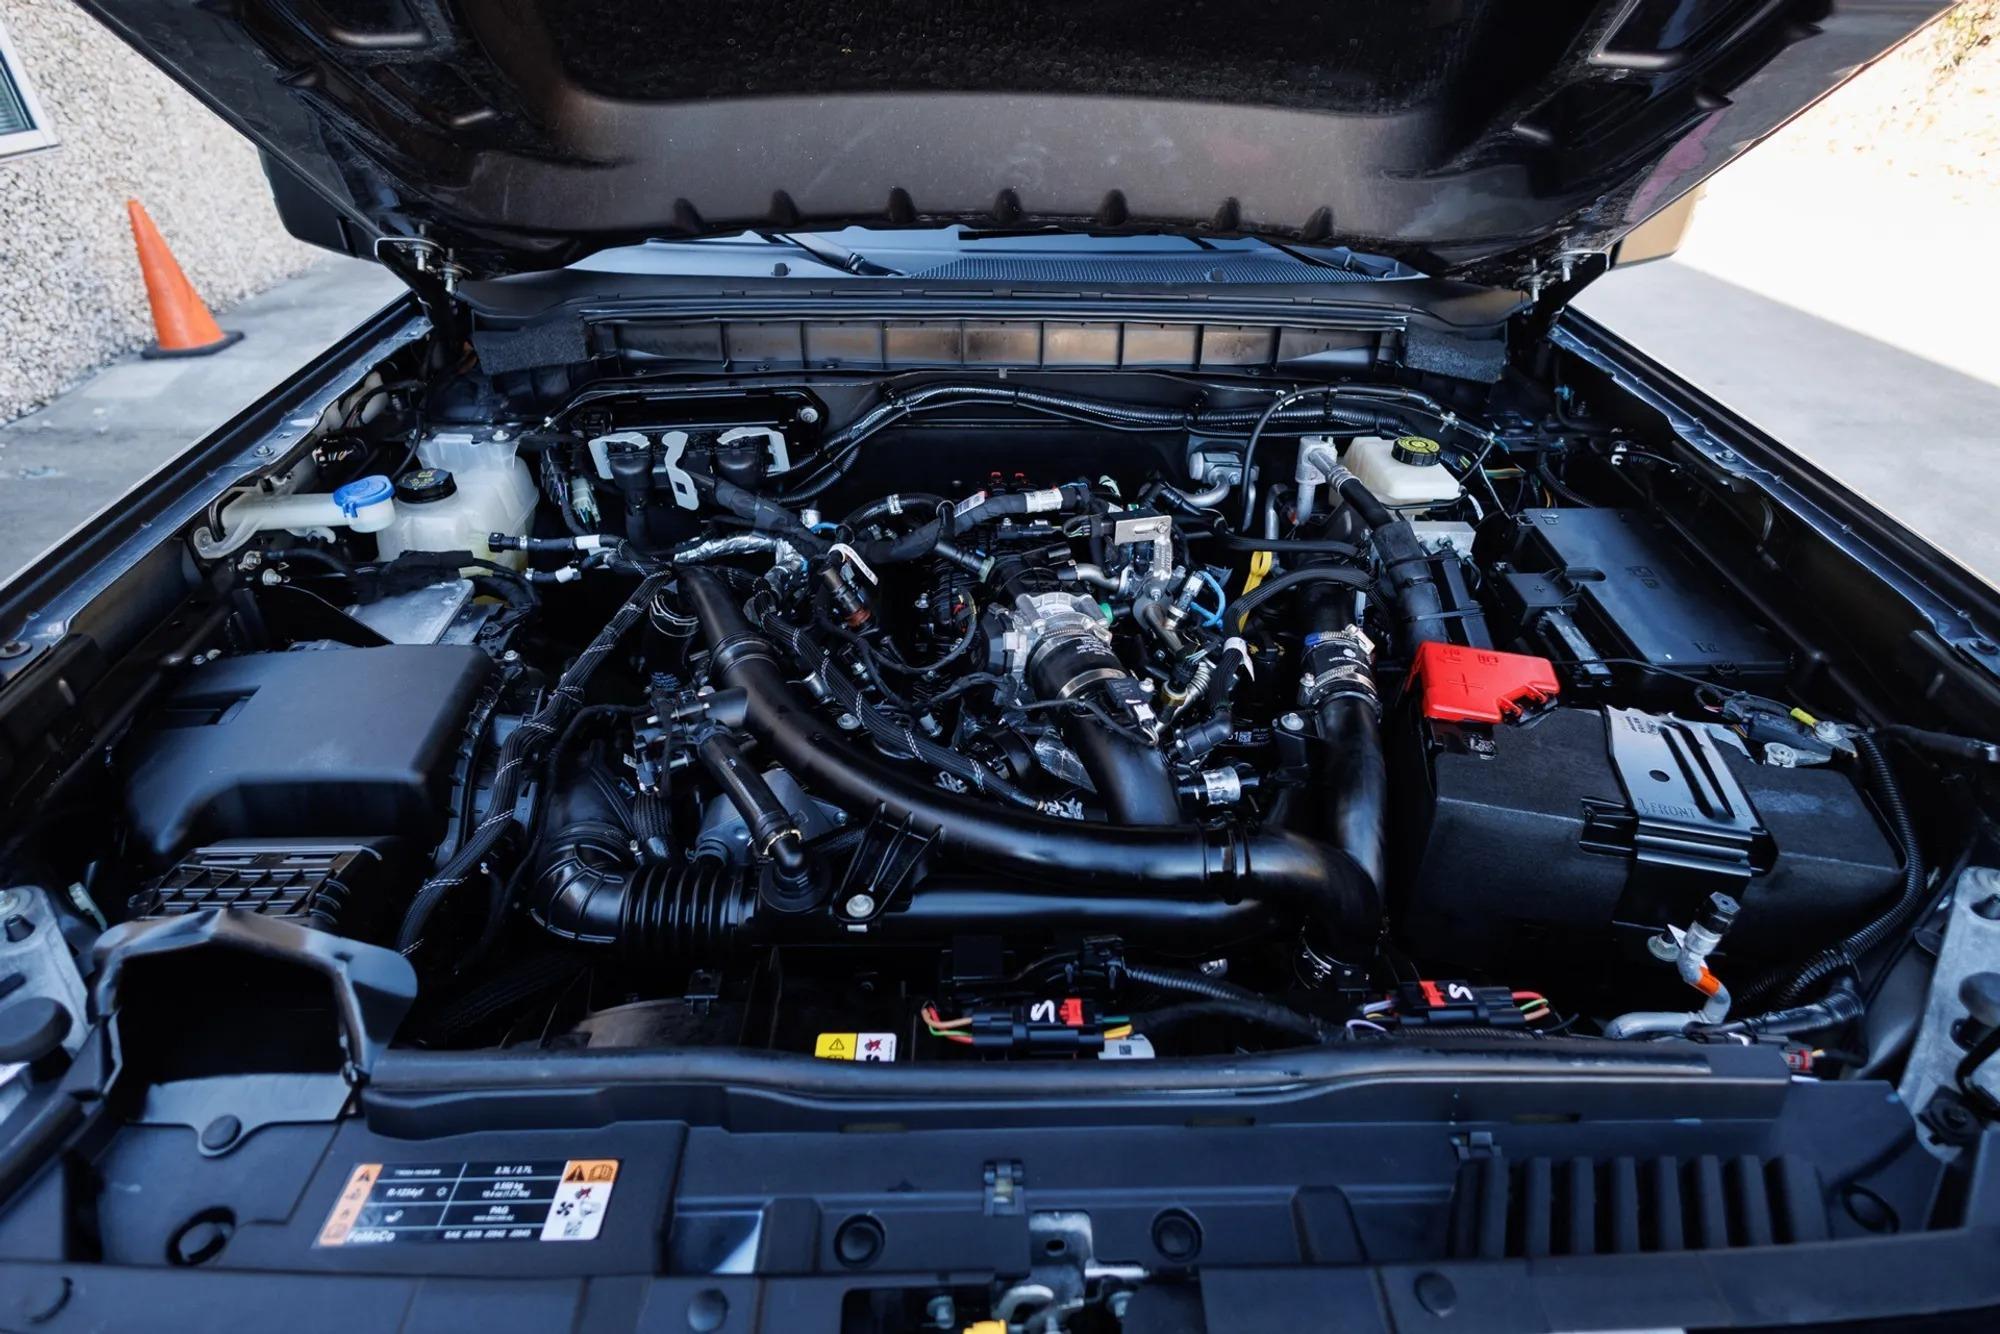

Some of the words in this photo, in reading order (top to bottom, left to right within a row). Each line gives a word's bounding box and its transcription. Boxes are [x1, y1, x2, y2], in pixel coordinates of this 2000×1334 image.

[1650, 803, 1696, 819] FRONT
[489, 1206, 510, 1215] PAG
[346, 1230, 396, 1242] FoMoCo
